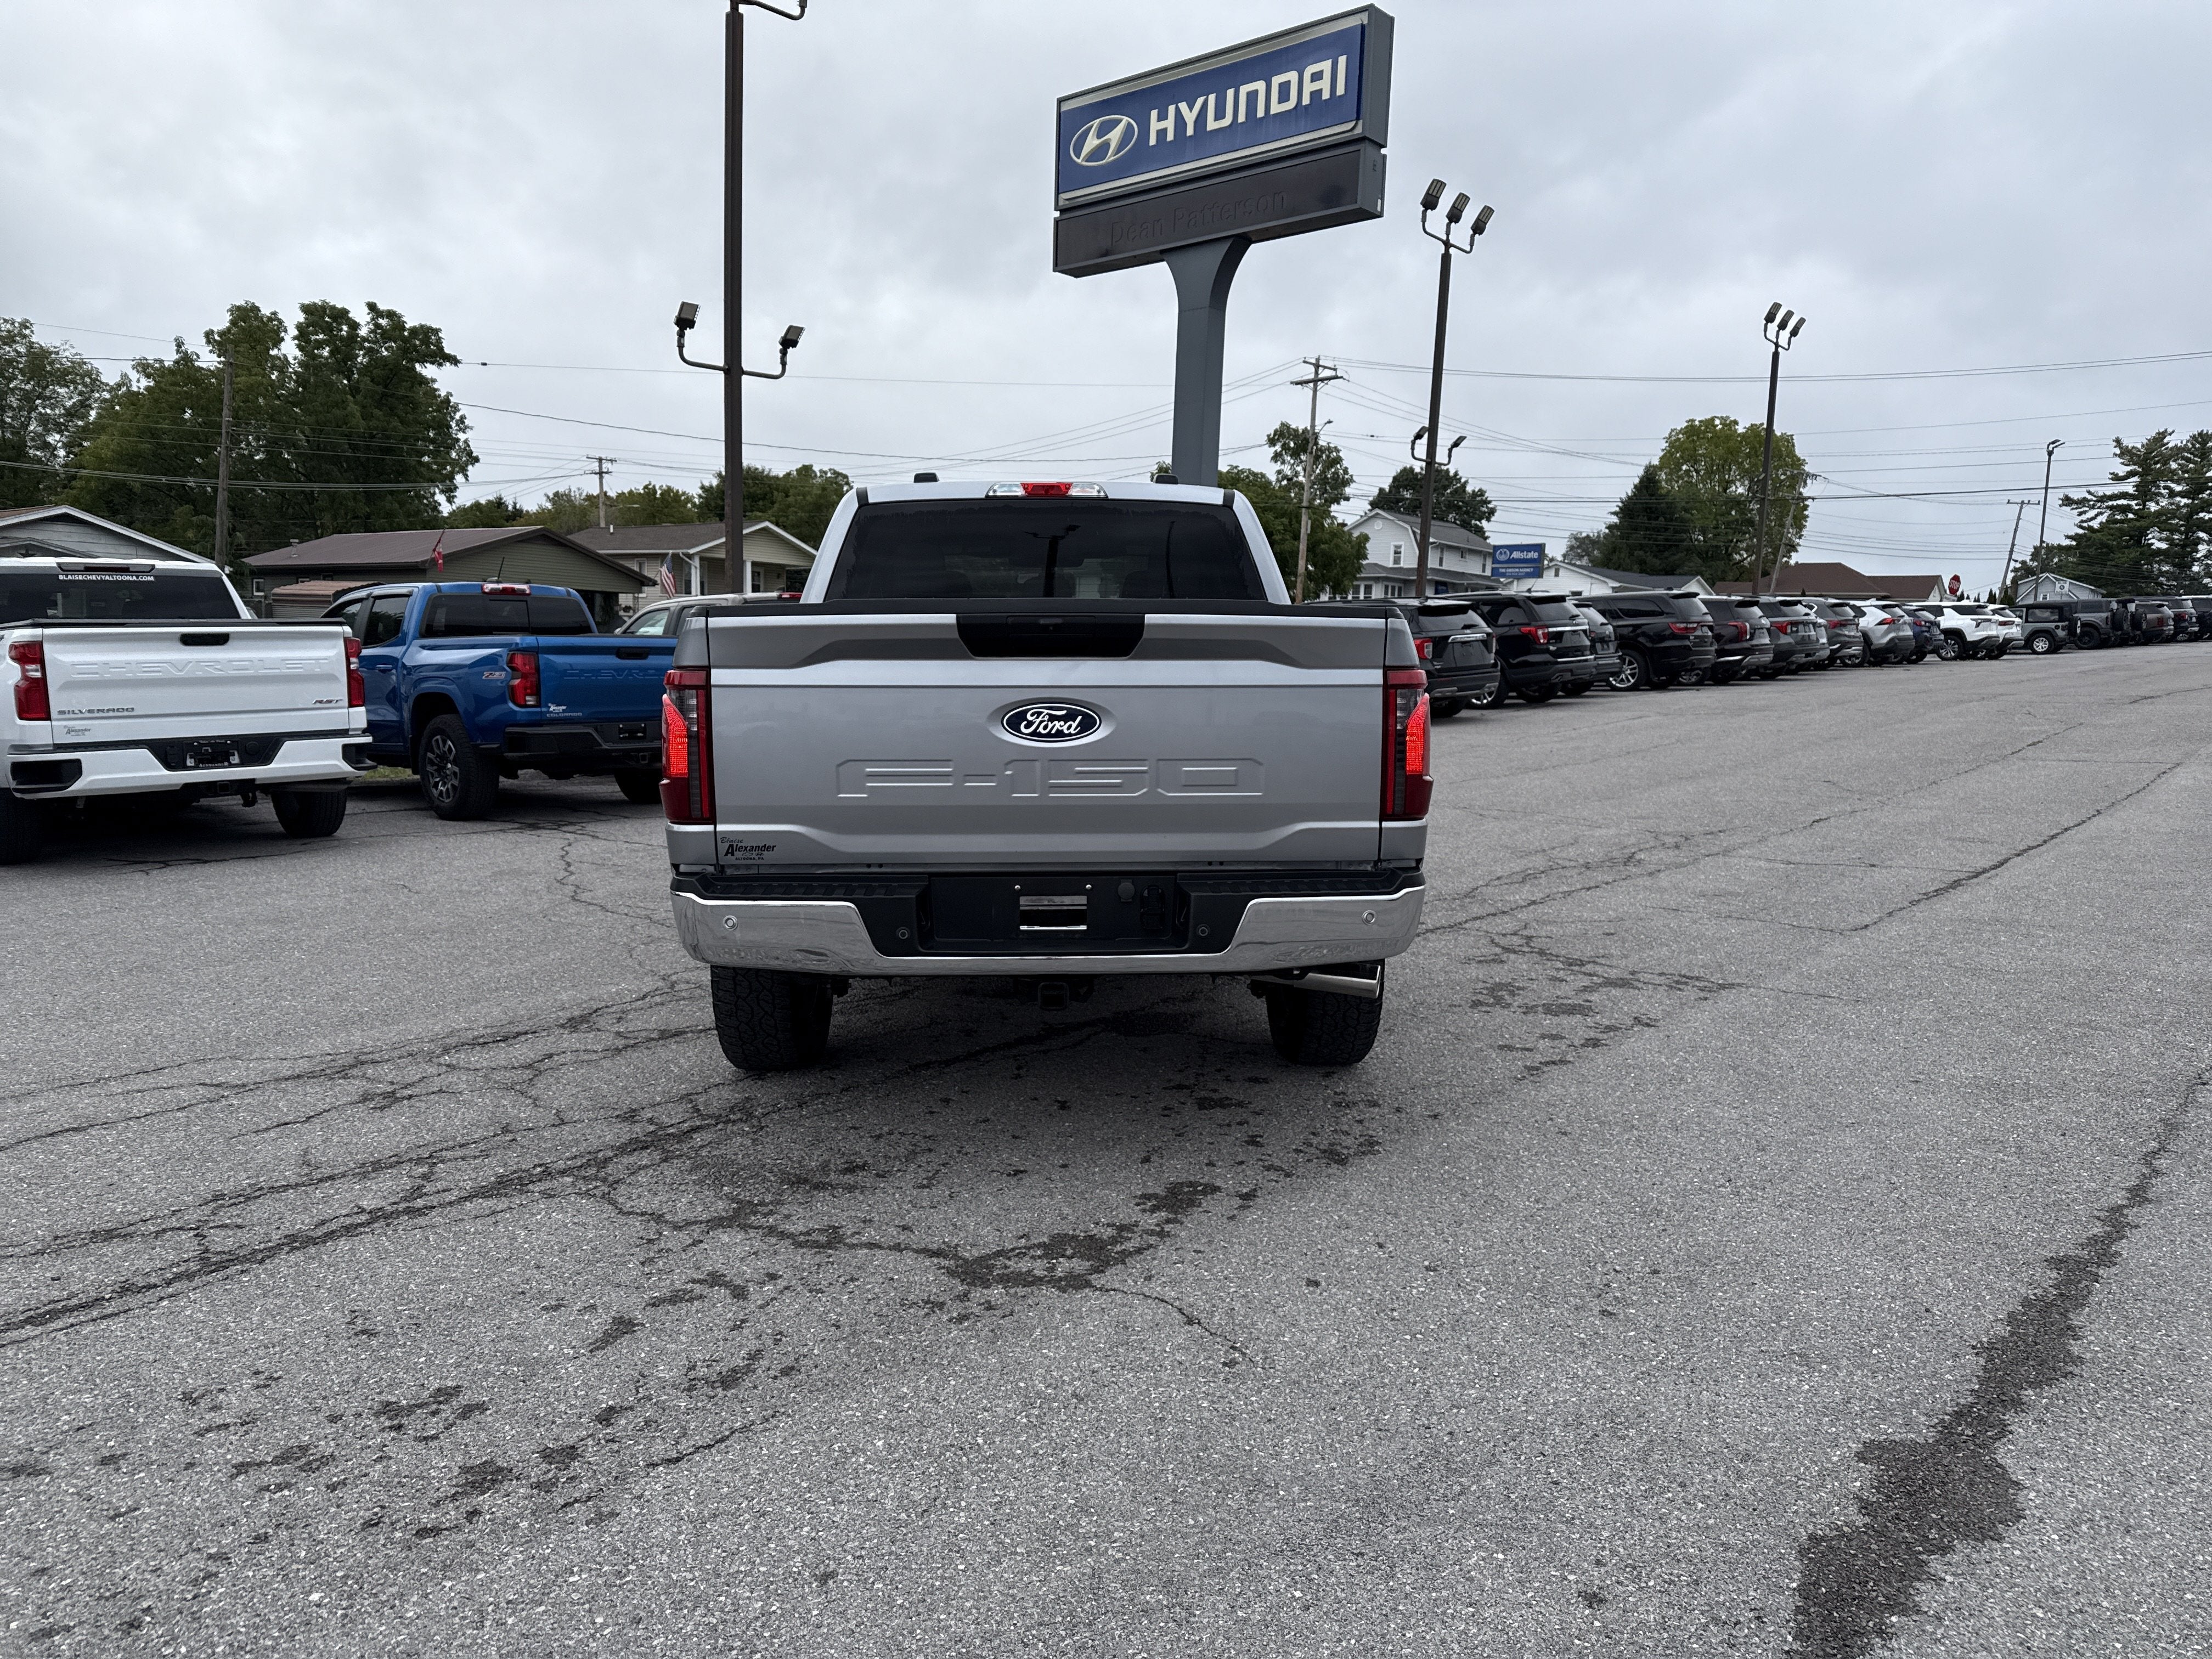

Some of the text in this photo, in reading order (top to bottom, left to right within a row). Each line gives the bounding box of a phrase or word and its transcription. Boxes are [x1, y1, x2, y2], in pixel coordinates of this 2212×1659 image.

[1149, 55, 1347, 146] HYUNDAI
[1111, 191, 1285, 246] Dean Patterson
[1510, 551, 1539, 559] Allstate
[1950, 580, 1960, 590] STOP
[70, 658, 328, 677] CHEVROLET
[1020, 708, 1081, 735] Ford
[836, 758, 1264, 797] F-150
[724, 844, 777, 857] Alexander
